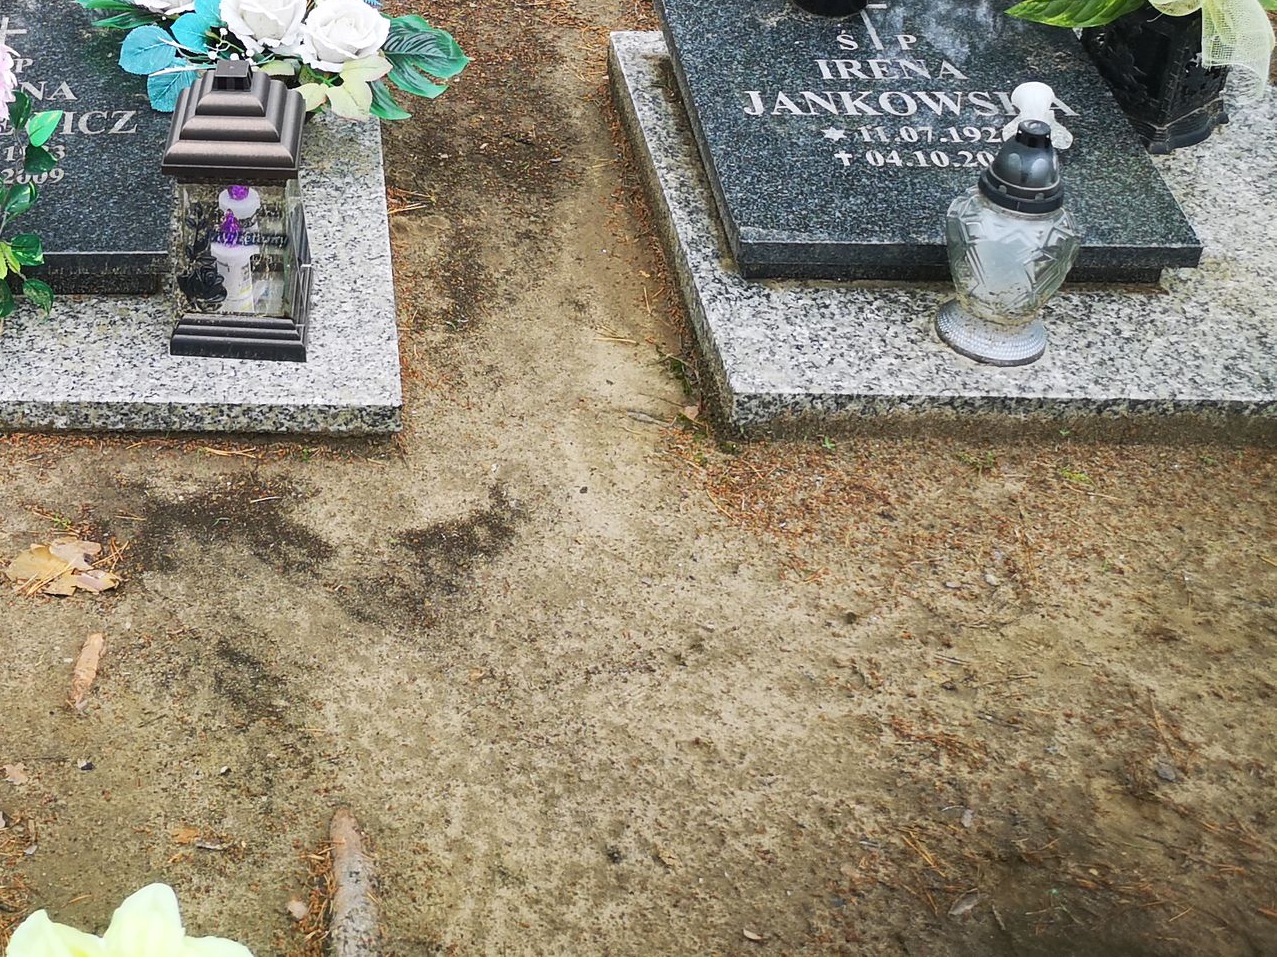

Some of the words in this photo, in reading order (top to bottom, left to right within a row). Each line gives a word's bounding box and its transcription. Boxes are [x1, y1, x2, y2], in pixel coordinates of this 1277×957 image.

[835, 29, 860, 51] Ś
[896, 34, 919, 51] P
[13, 57, 34, 74] P
[813, 58, 970, 81] IRENA
[857, 125, 1005, 144] 11.07.192
[865, 149, 997, 169] 04.10.20
